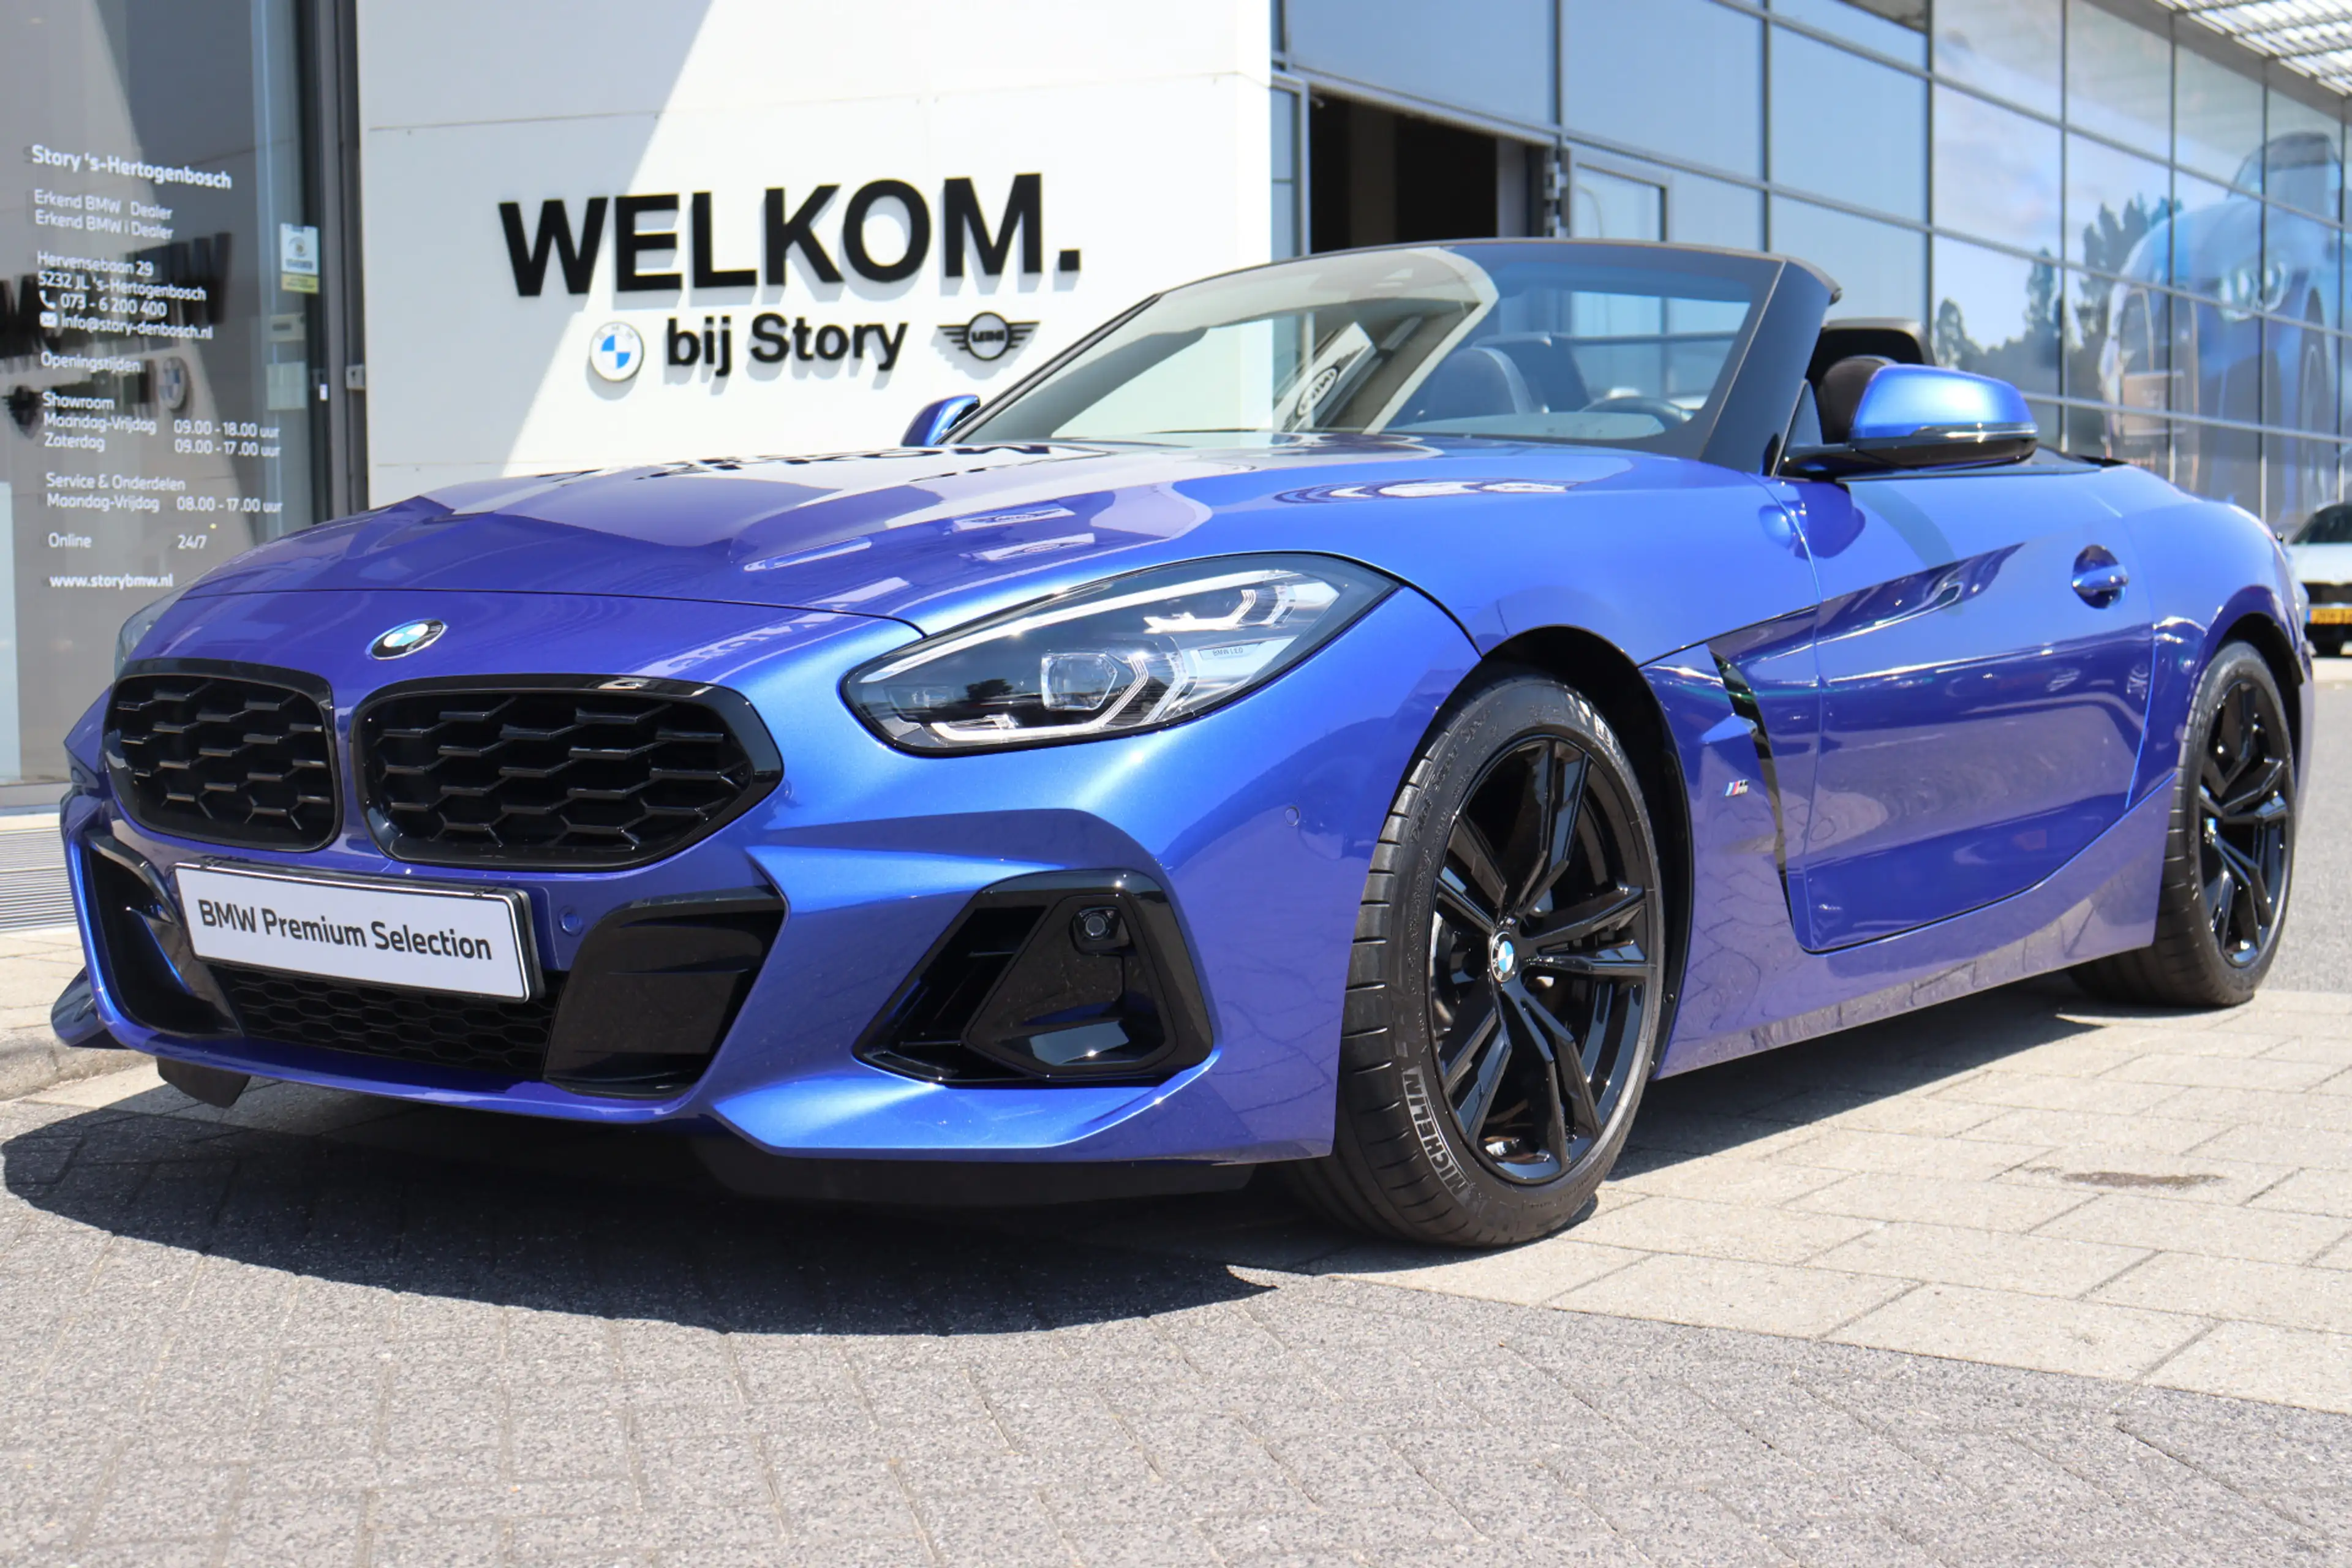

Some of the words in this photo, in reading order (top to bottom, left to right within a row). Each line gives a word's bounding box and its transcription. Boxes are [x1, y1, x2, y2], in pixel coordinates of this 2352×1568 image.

[32, 144, 81, 173] Story
[84, 152, 232, 189] 's-Hertogenbosch
[34, 189, 82, 209] Erkend
[85, 195, 121, 214] BMW
[130, 201, 173, 220] Dealer
[35, 209, 83, 229] Erkend
[86, 216, 121, 233] BMW
[131, 221, 173, 239] Dealer
[499, 172, 1082, 297] WELKOM.
[37, 251, 134, 274] Hervensebaan
[136, 260, 153, 276] 29
[38, 271, 72, 288] 5232
[92, 277, 206, 301] 's-Hertogenbosch
[60, 292, 87, 309] 073
[99, 296, 108, 312] 6
[111, 299, 138, 314] 200
[140, 301, 167, 317] 400
[668, 317, 731, 377] bij
[750, 312, 908, 372] Story
[40, 351, 141, 373] Openingstijden
[42, 391, 115, 410] Showroom
[43, 412, 157, 435] Maandag-Vrijdag
[174, 419, 213, 435] 09.00
[222, 421, 258, 437] 18.00
[260, 428, 280, 438] uur
[44, 432, 105, 453] Zaterdag
[175, 439, 213, 454] 09.00
[260, 447, 281, 458] uur
[46, 472, 96, 489] Service
[98, 473, 109, 489] &
[111, 475, 186, 491] Onderdelen
[47, 492, 160, 513] Maandag-Vrijdag
[176, 496, 215, 511] 08.00
[263, 502, 283, 513] uur
[48, 532, 92, 548] Online
[178, 534, 207, 549] 24/7
[49, 573, 173, 590] www.storybmw.nl
[198, 899, 256, 933] BMW
[261, 908, 367, 948] Premium
[371, 921, 492, 960] Selection
[1403, 1070, 1470, 1197] MICHELIN
